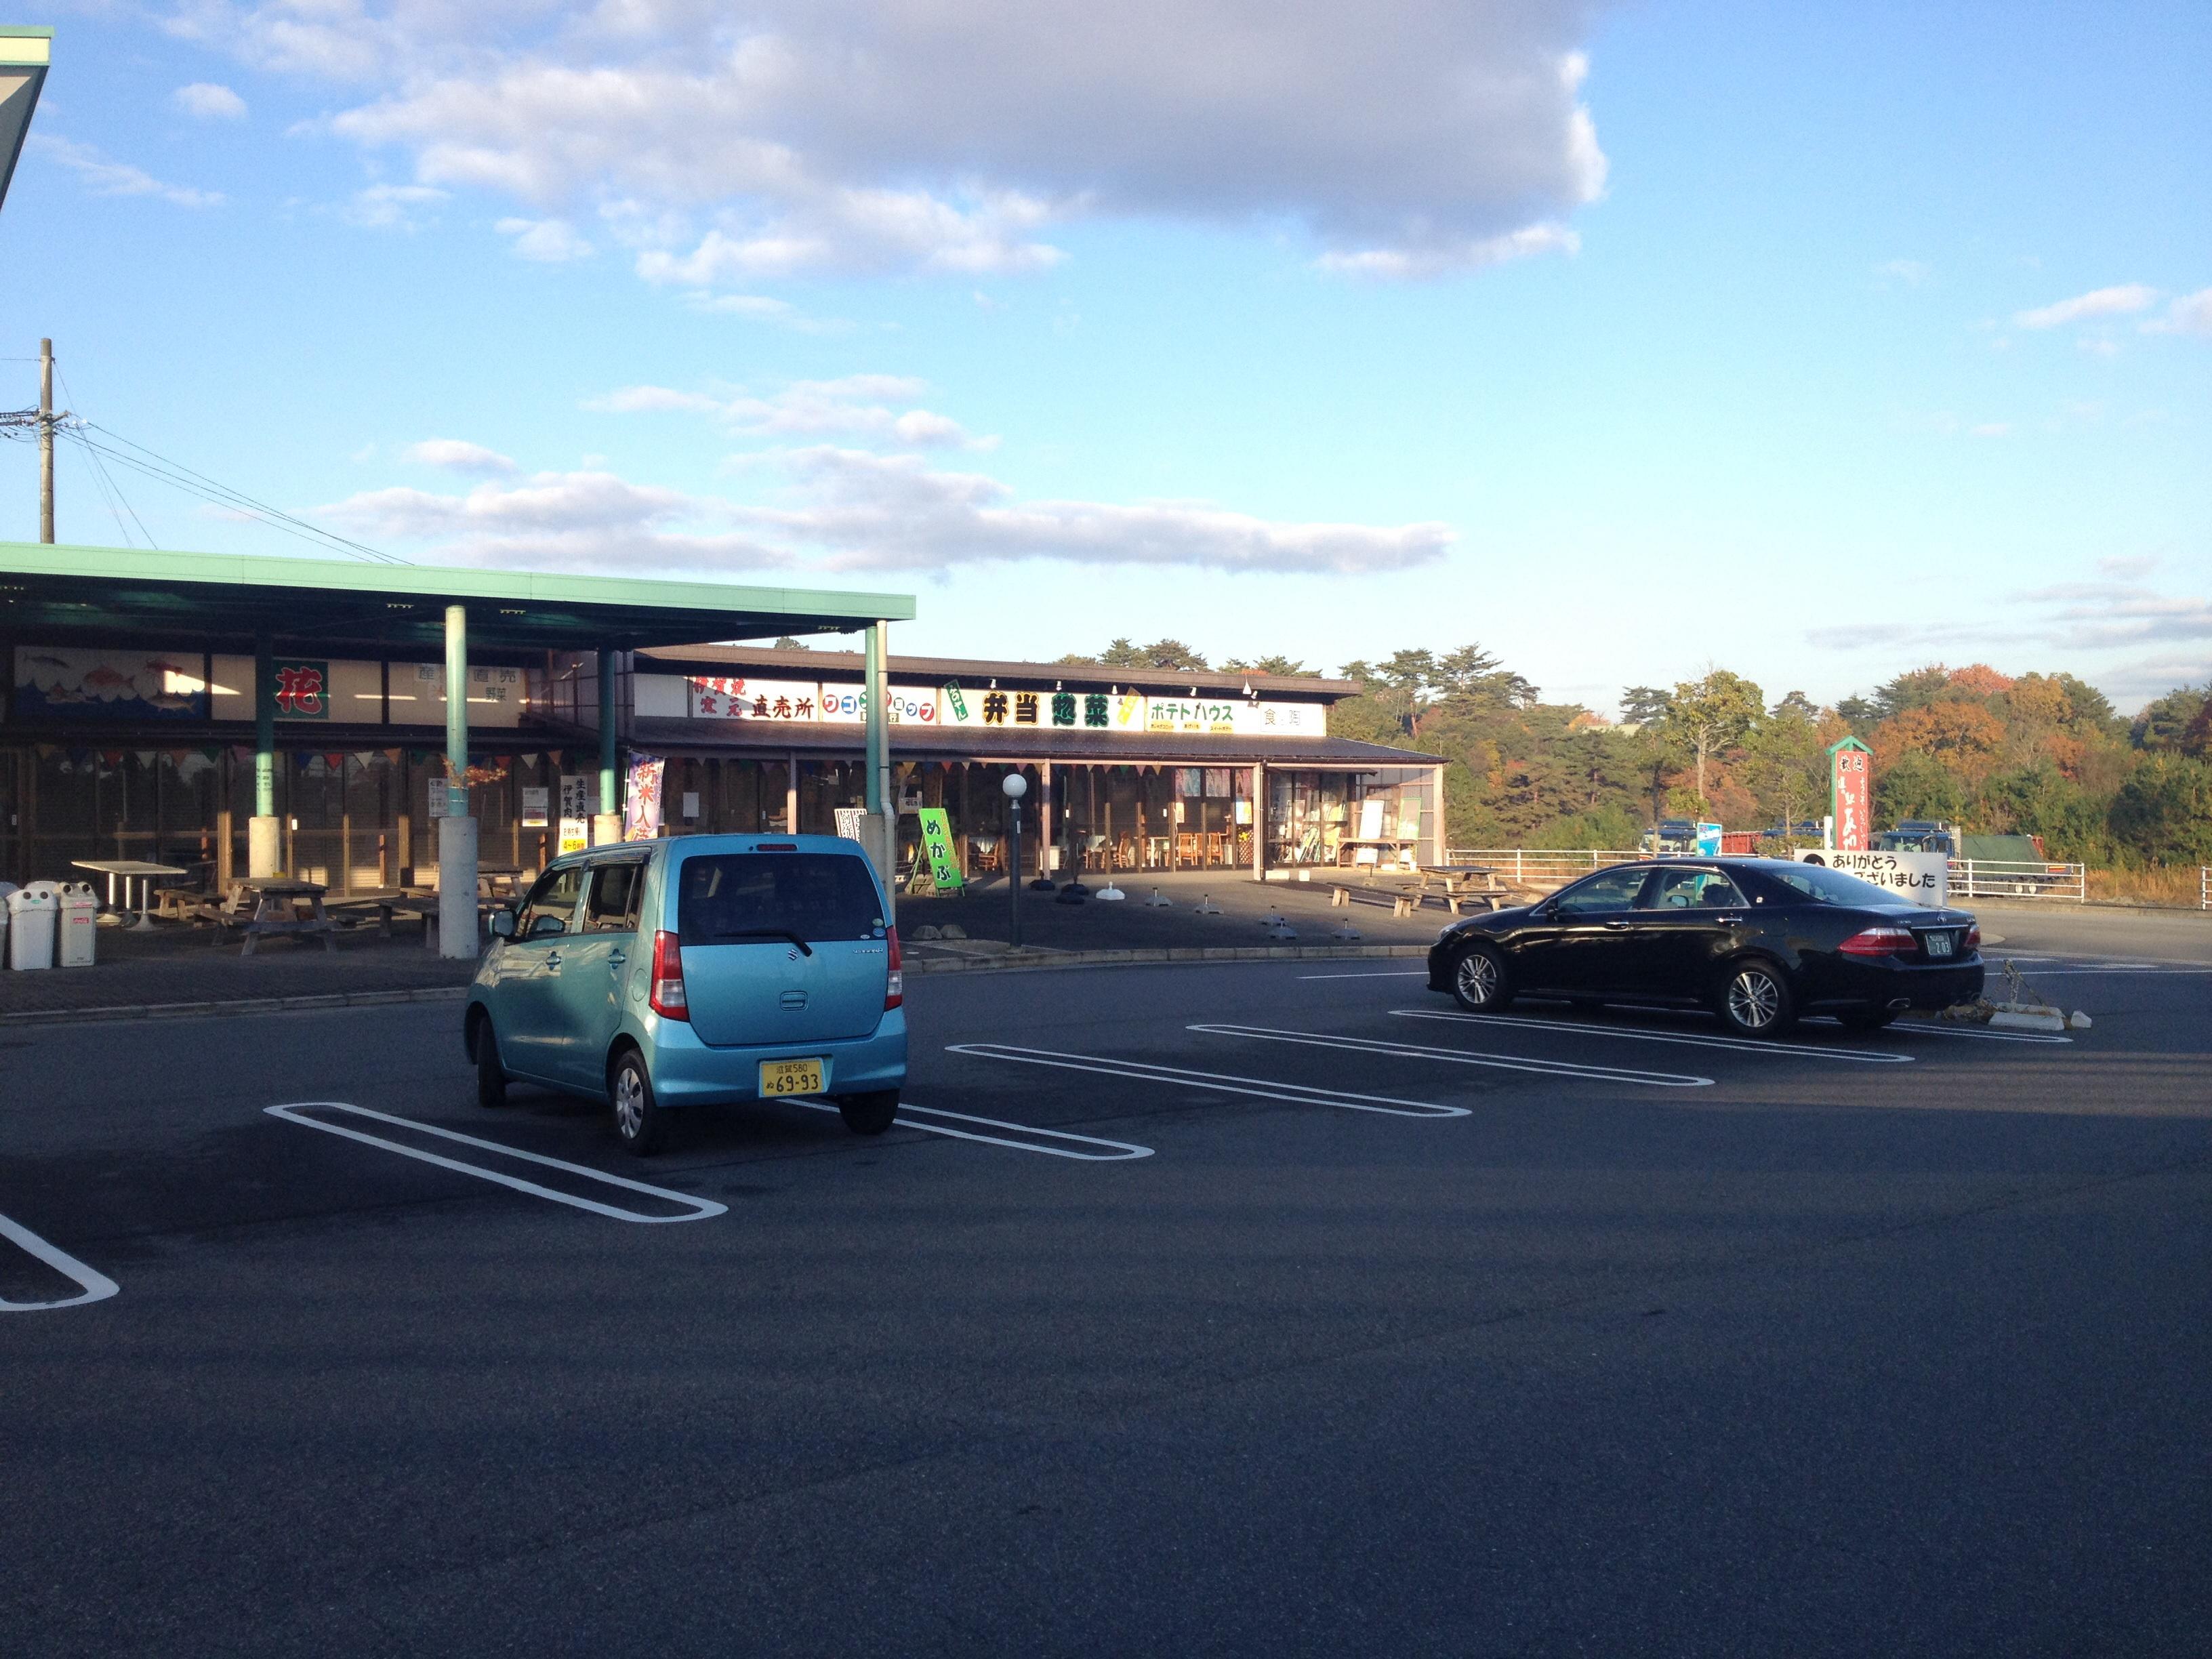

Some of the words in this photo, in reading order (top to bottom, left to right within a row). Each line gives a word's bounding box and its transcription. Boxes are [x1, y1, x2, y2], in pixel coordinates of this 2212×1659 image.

[275, 666, 322, 714] 花
[751, 694, 814, 720] 直売所
[983, 691, 1040, 725] 弁当
[1052, 693, 1109, 727] 惣菜
[1151, 703, 1233, 721] ポテトハウス
[564, 785, 573, 818] 伊賀肉
[926, 819, 952, 881] めかぶ
[1833, 855, 1897, 870] ありがとう
[777, 1074, 818, 1092] 69-93
